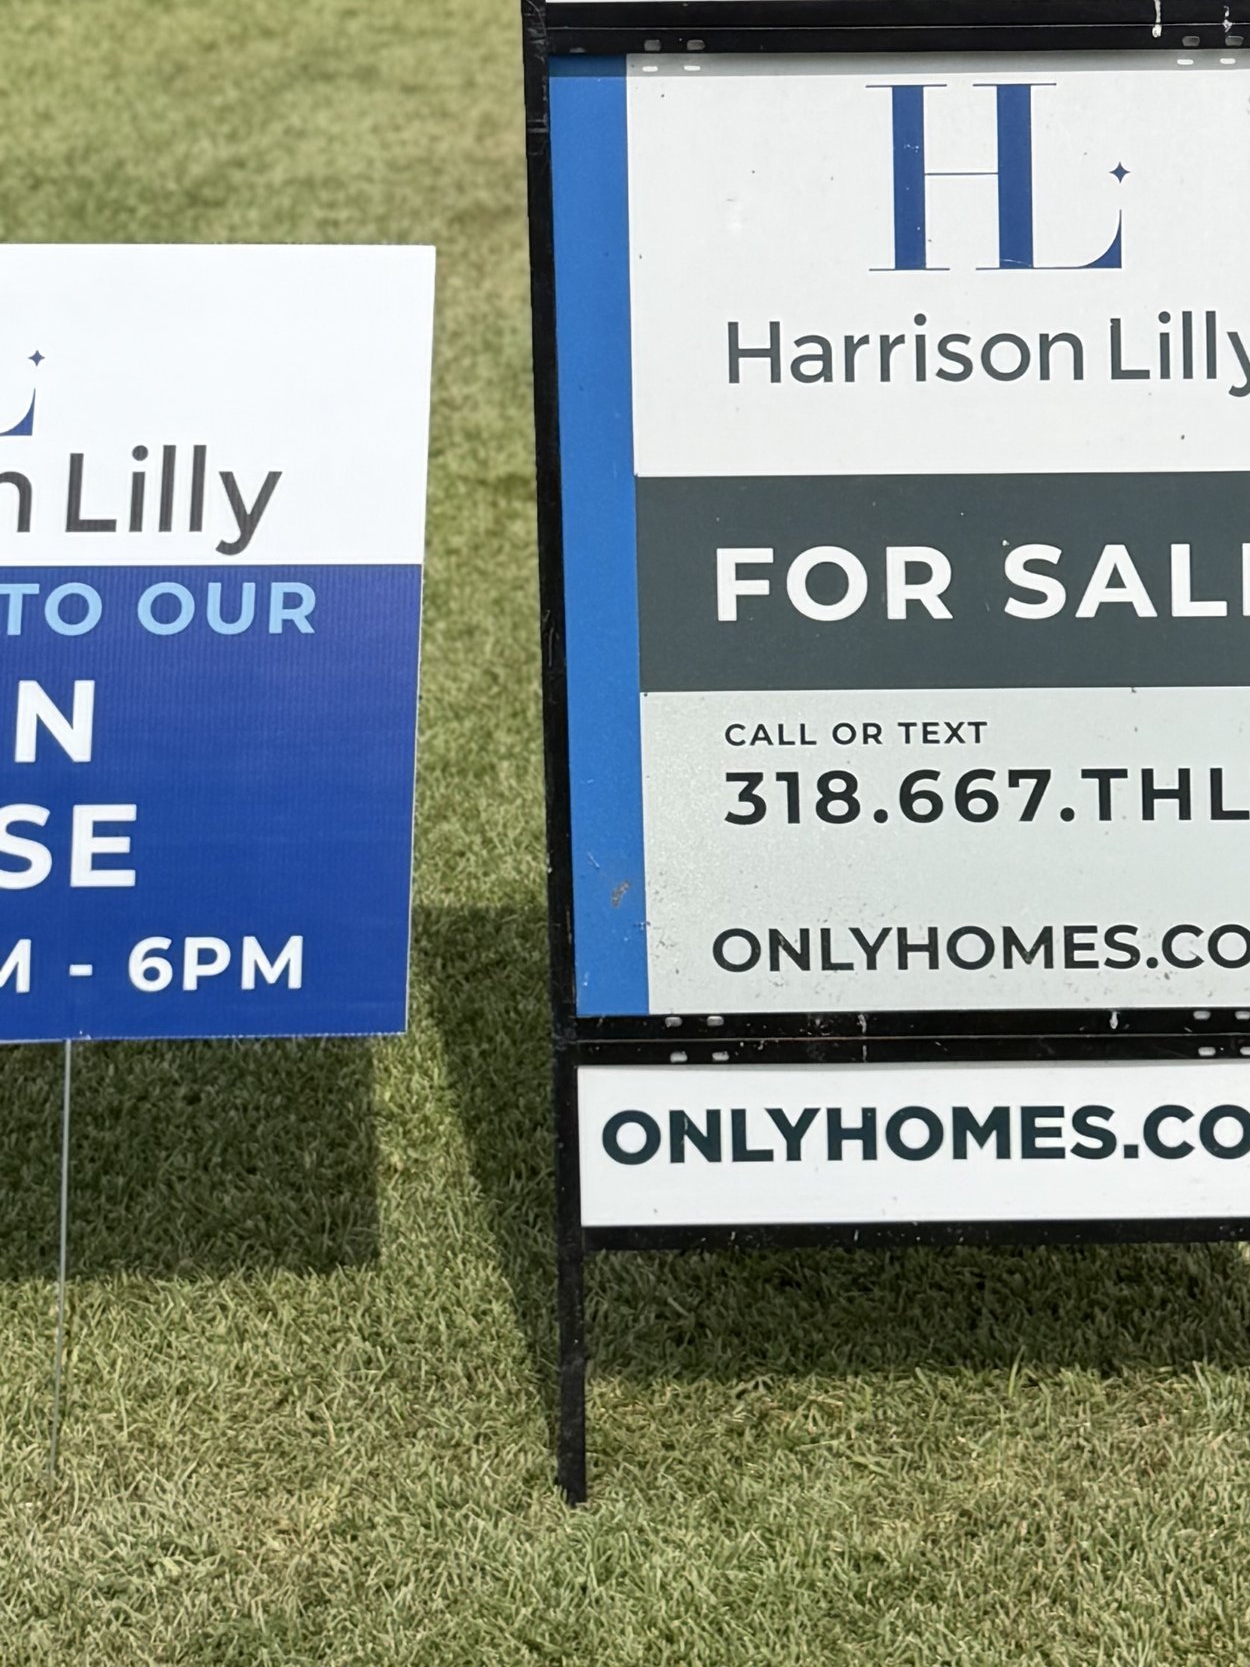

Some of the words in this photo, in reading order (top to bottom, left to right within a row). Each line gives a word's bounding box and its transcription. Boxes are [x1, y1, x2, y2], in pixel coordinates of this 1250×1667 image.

[865, 82, 1123, 272] HL
[727, 312, 1084, 384] Harrison
[65, 444, 283, 556] Lilly
[0, 581, 103, 636] TO
[137, 581, 316, 636] OUR
[716, 545, 954, 622] FOR
[724, 723, 818, 747] CALL
[831, 722, 883, 746] OR
[897, 721, 988, 745] TEXT
[128, 935, 303, 992] 6PM
